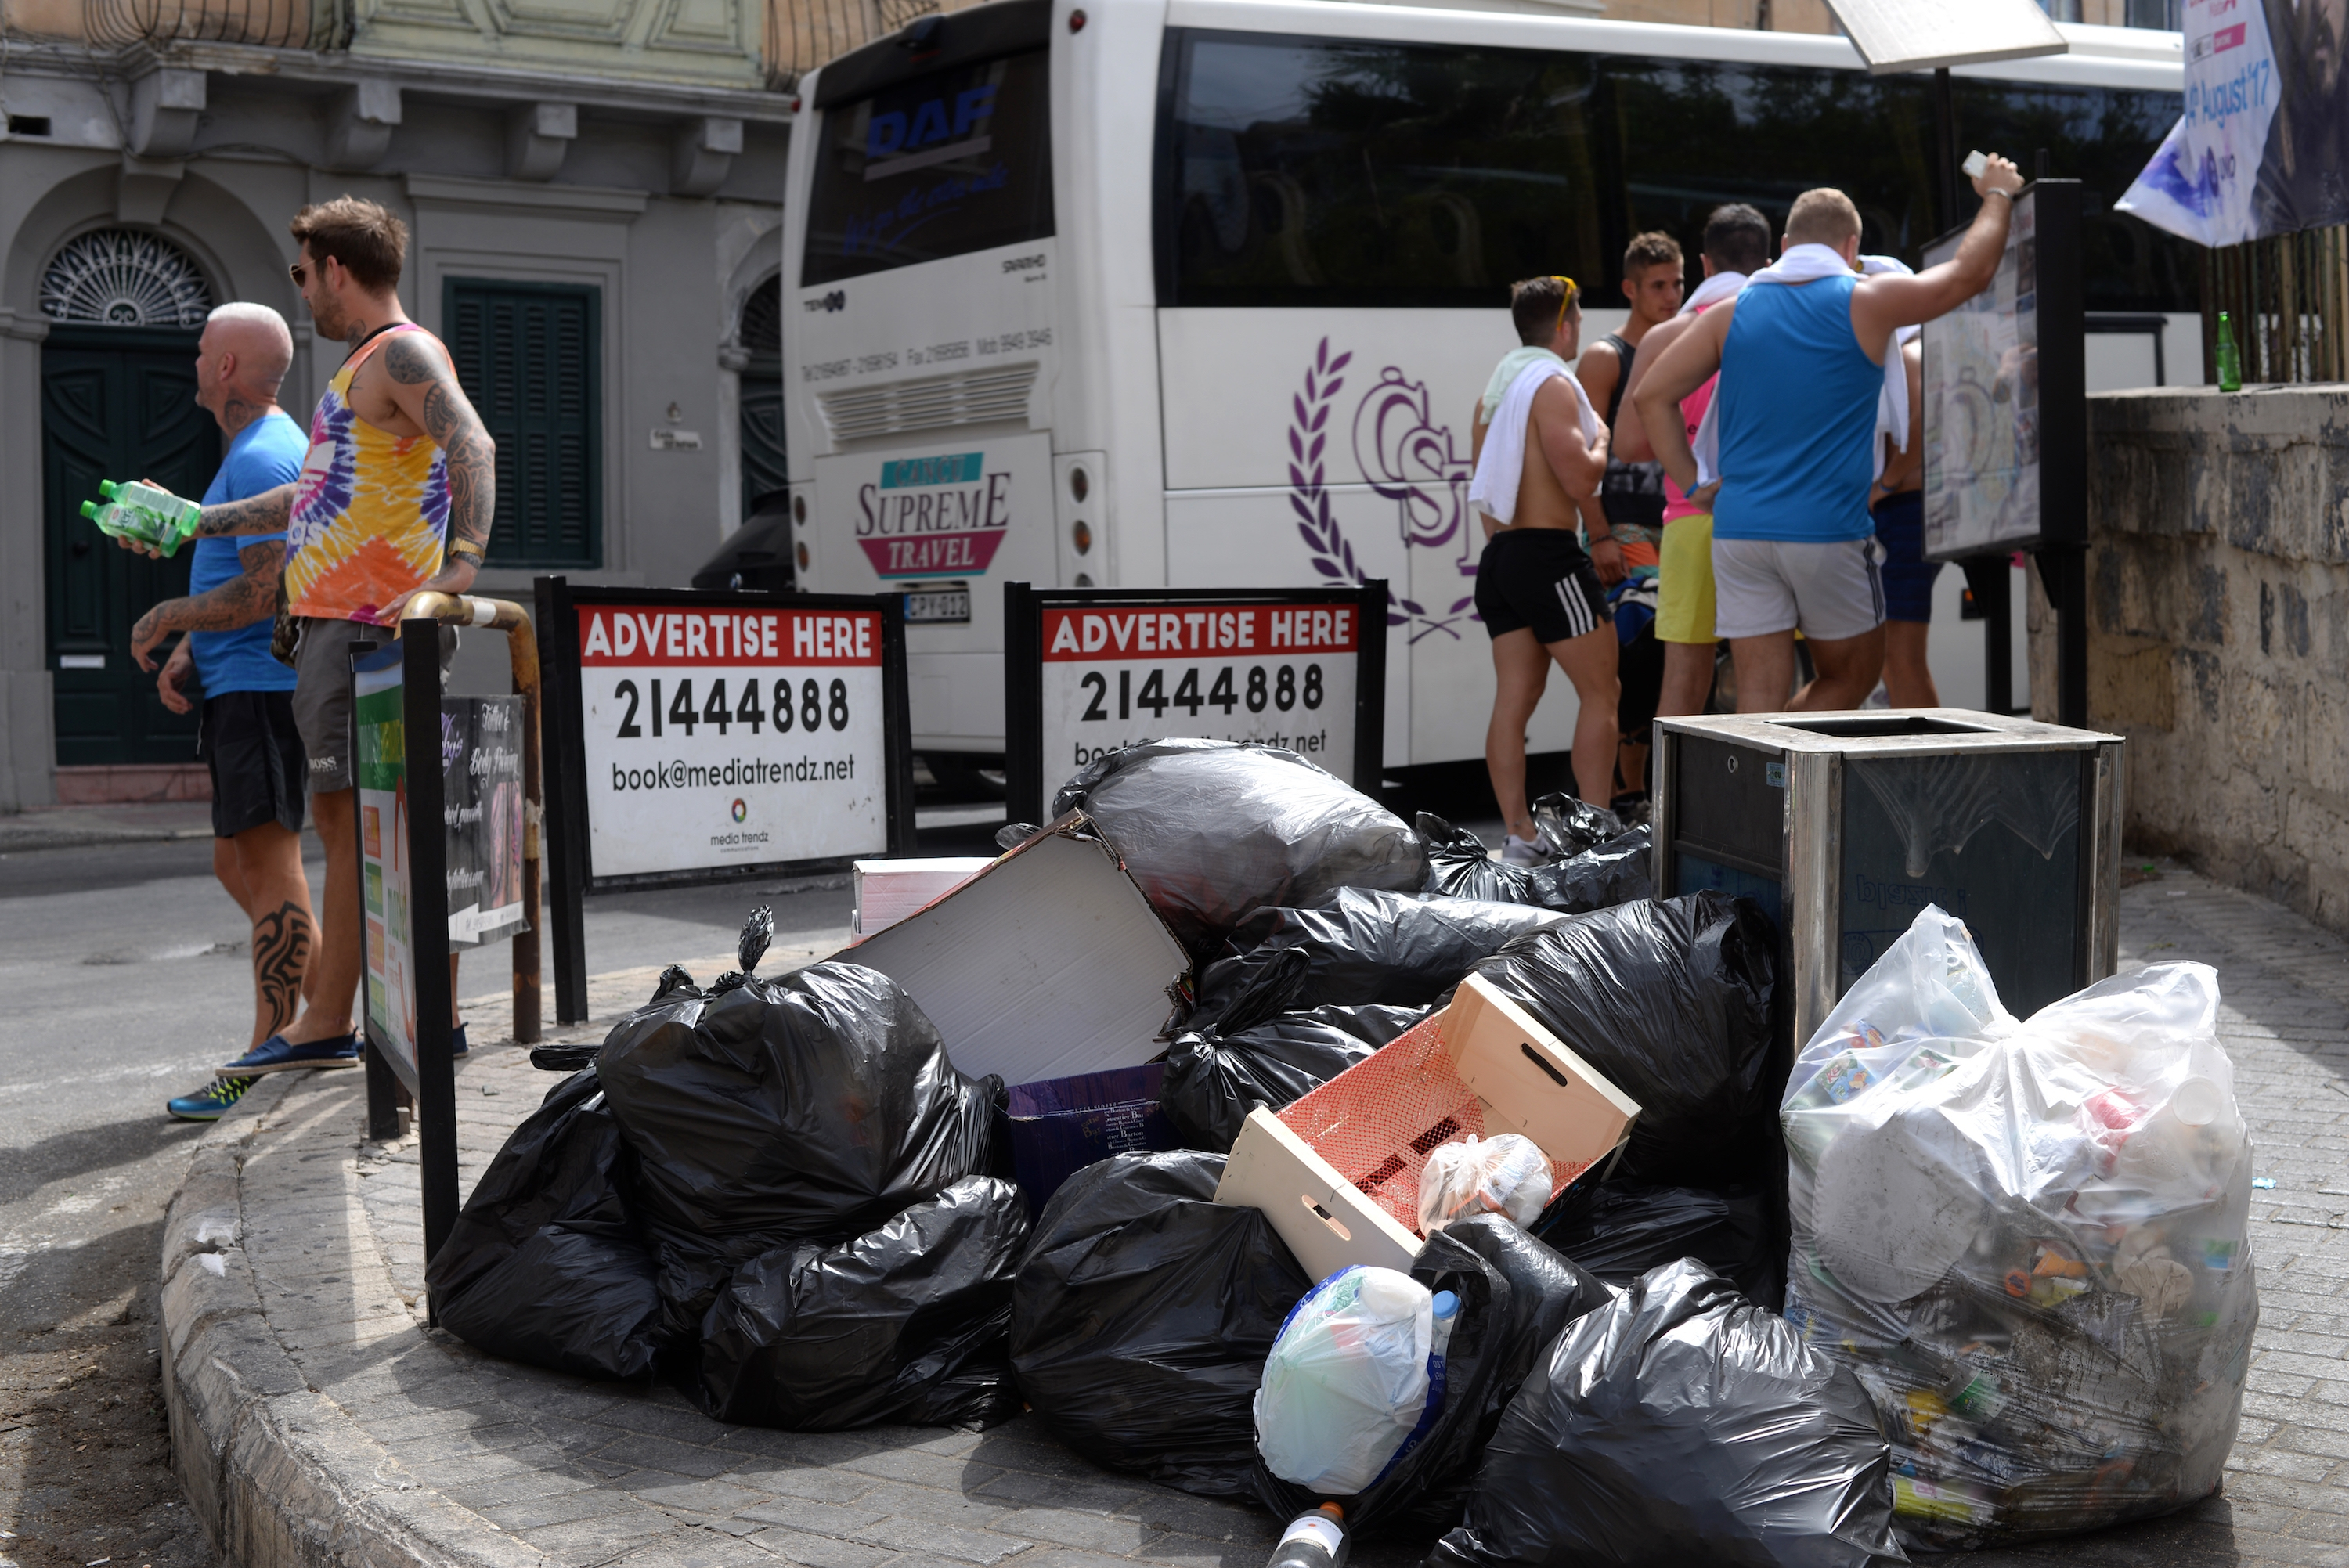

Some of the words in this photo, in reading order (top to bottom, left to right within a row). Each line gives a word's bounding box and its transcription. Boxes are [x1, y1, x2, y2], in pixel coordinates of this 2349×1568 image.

[866, 83, 998, 157] DAF
[856, 471, 1011, 536] SUPREME
[889, 538, 975, 569] TRAVEL
[583, 611, 778, 658] ADVERTISE
[793, 616, 871, 658] HERE
[1050, 611, 1255, 654] ADVERTISE
[1271, 609, 1351, 647] HERE
[614, 678, 849, 737] 21444888
[1081, 663, 1323, 722] 21444888
[612, 754, 855, 791] book@mediatrendz.net
[710, 832, 739, 845] media
[742, 830, 769, 843] trendz
